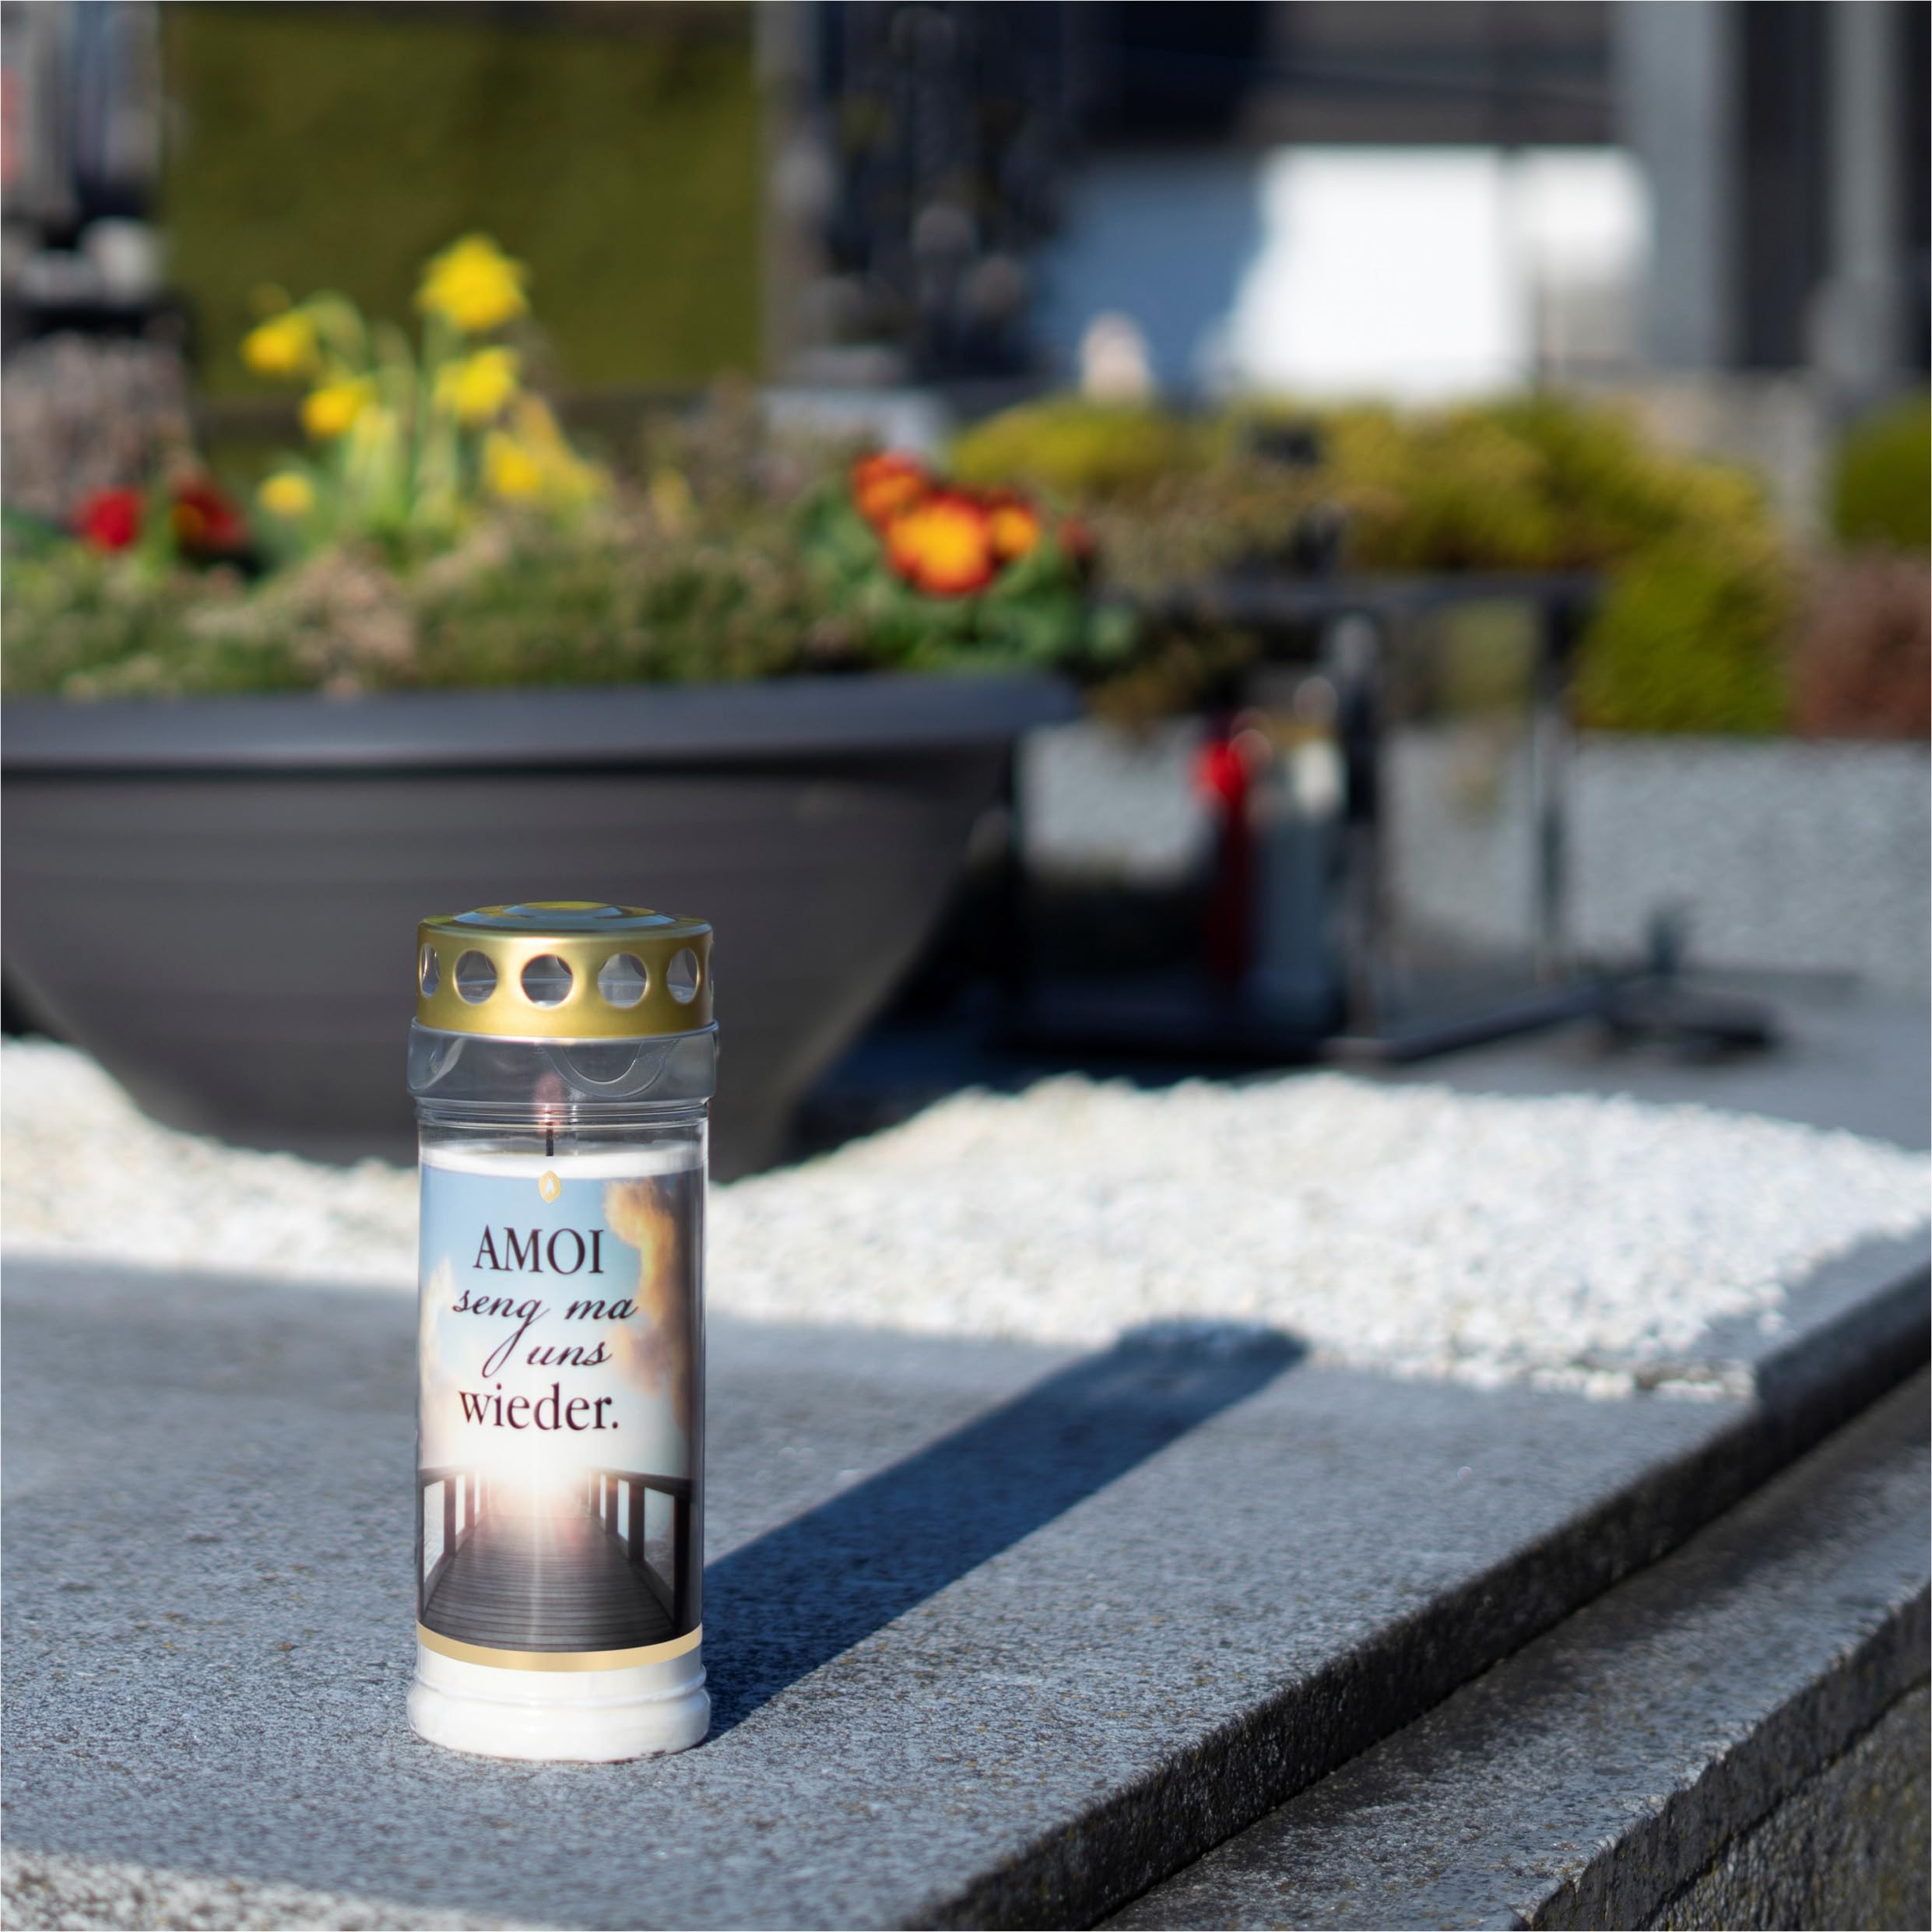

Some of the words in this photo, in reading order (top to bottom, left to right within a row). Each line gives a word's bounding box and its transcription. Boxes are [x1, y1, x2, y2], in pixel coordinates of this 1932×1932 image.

[472, 1224, 604, 1275] AMOI
[452, 1290, 550, 1378] seng
[564, 1298, 639, 1320] ma
[527, 1341, 613, 1366] uns
[458, 1381, 618, 1431] wieder.
